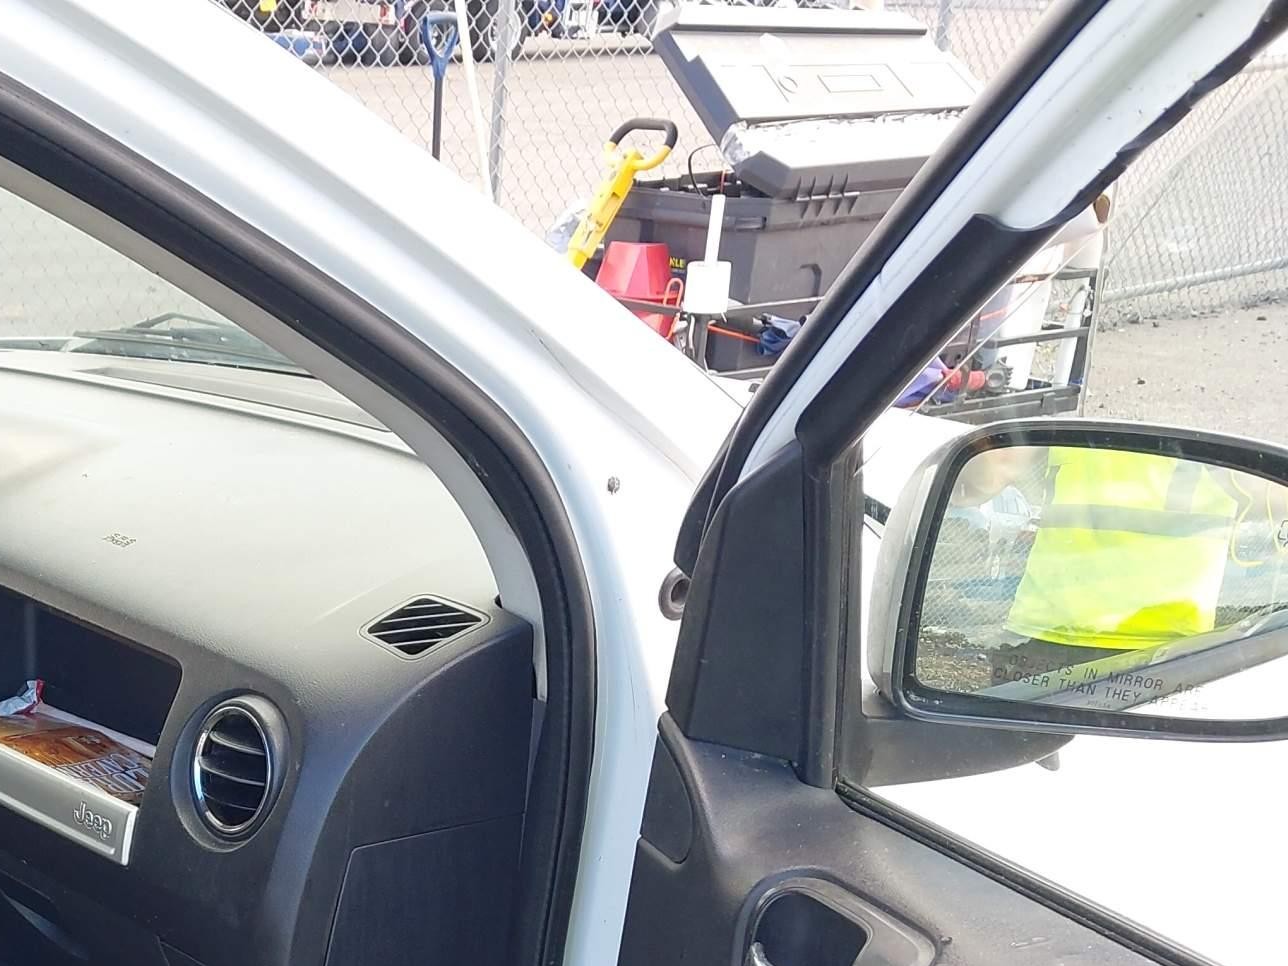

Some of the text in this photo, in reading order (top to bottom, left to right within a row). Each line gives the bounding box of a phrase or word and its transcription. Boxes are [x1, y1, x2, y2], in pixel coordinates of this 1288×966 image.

[993, 666, 1050, 688] CLOSER
[1058, 678, 1097, 696] THAN
[1105, 686, 1141, 704] THEY
[1083, 667, 1098, 680] IN
[1108, 671, 1164, 690] MIRROR
[73, 800, 112, 841] Jeep
